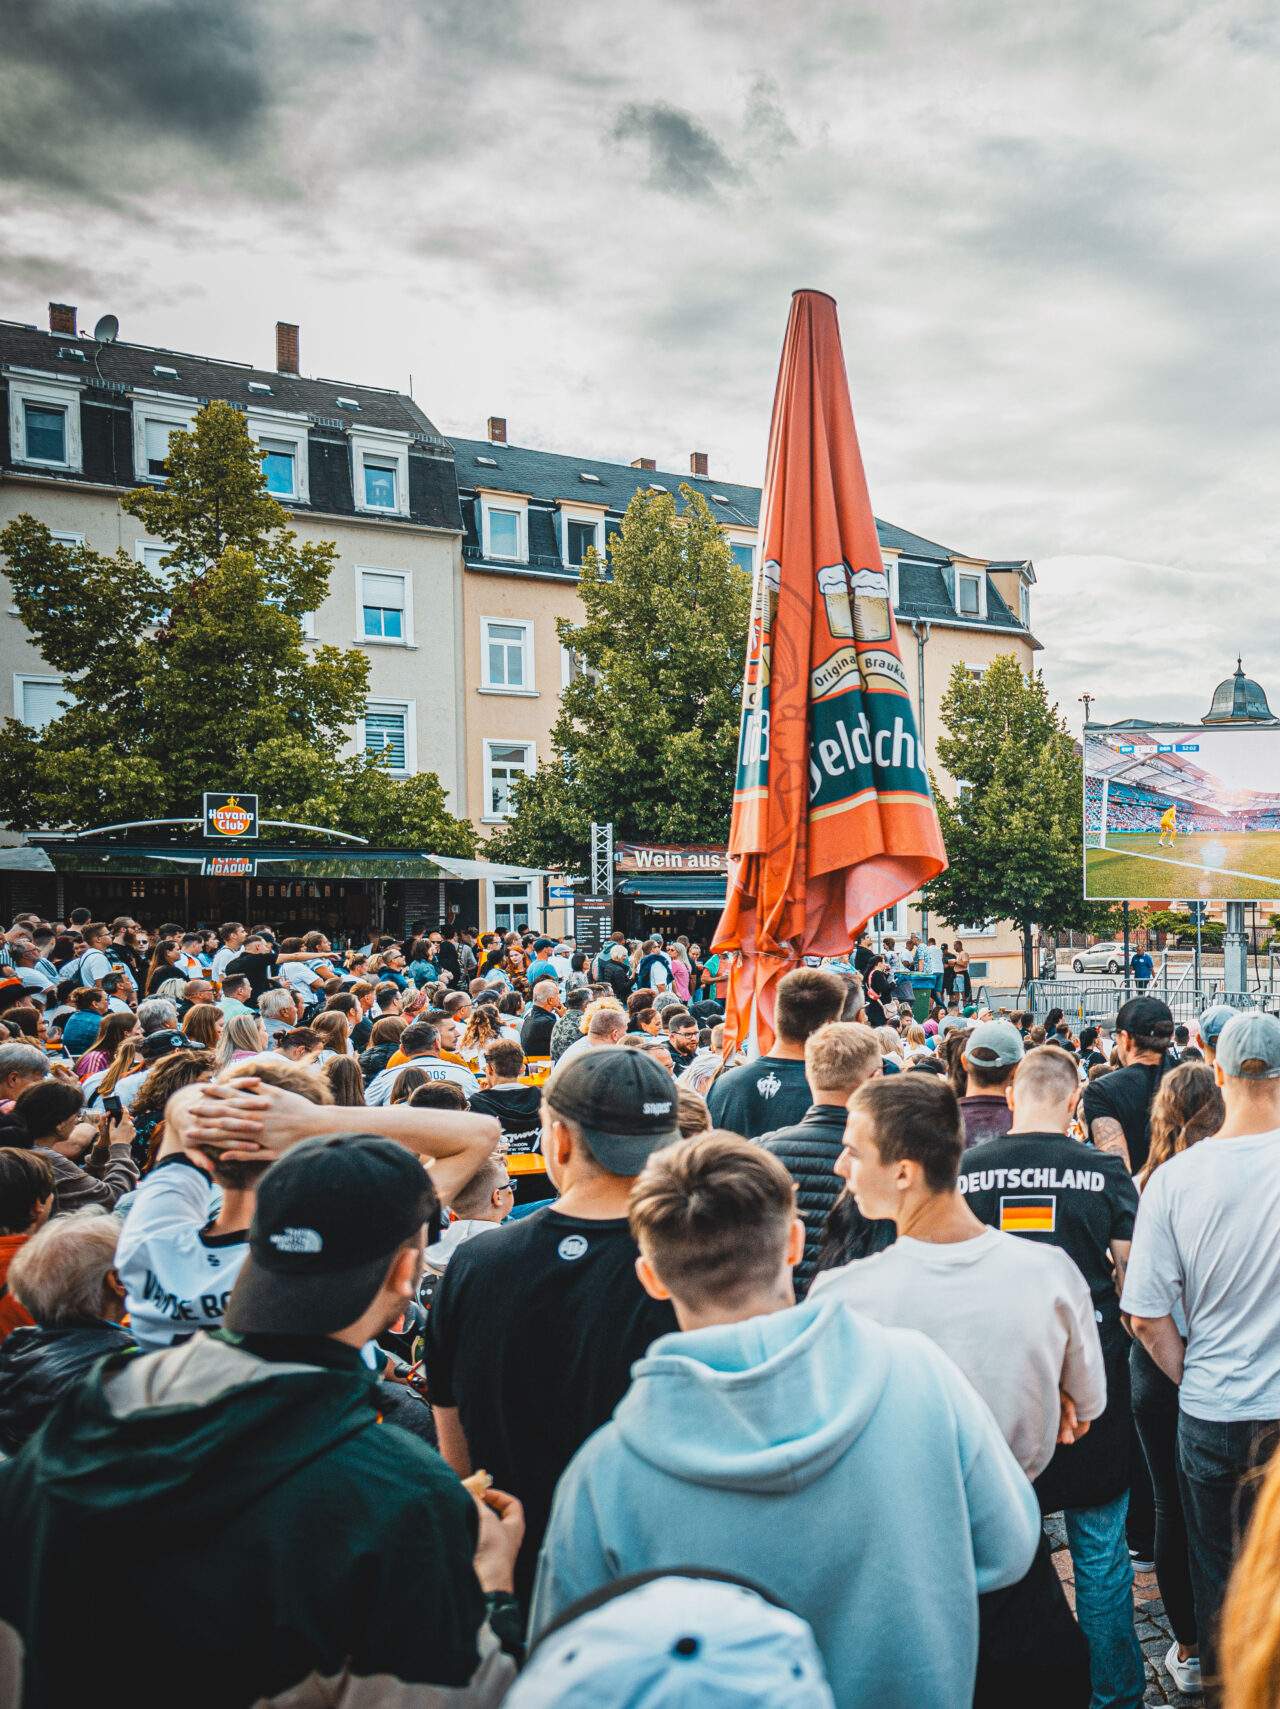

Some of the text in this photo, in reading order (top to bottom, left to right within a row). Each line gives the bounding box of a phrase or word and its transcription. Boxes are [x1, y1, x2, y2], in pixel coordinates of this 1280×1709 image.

[814, 654, 906, 687] Origina Brauku
[208, 808, 255, 821] Havana
[218, 819, 245, 831] Club
[634, 850, 721, 868] Wein aus
[956, 1167, 1106, 1195] DEUTSCHLAND
